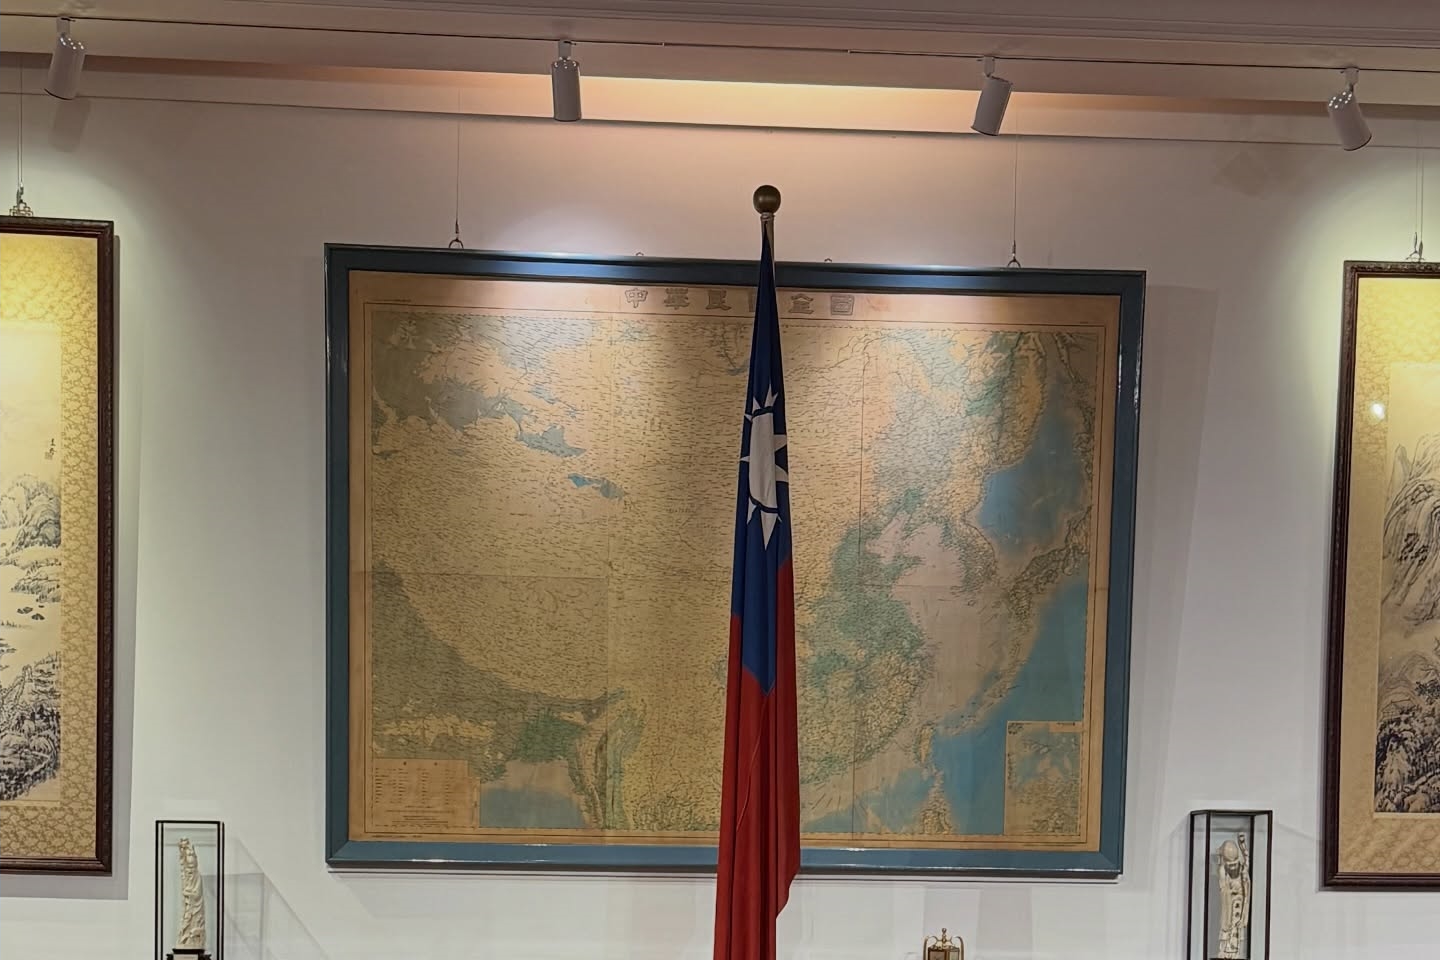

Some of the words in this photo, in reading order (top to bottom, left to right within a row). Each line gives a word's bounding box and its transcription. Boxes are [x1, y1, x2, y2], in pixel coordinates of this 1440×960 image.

[624, 287, 855, 316] 中華民全圖
